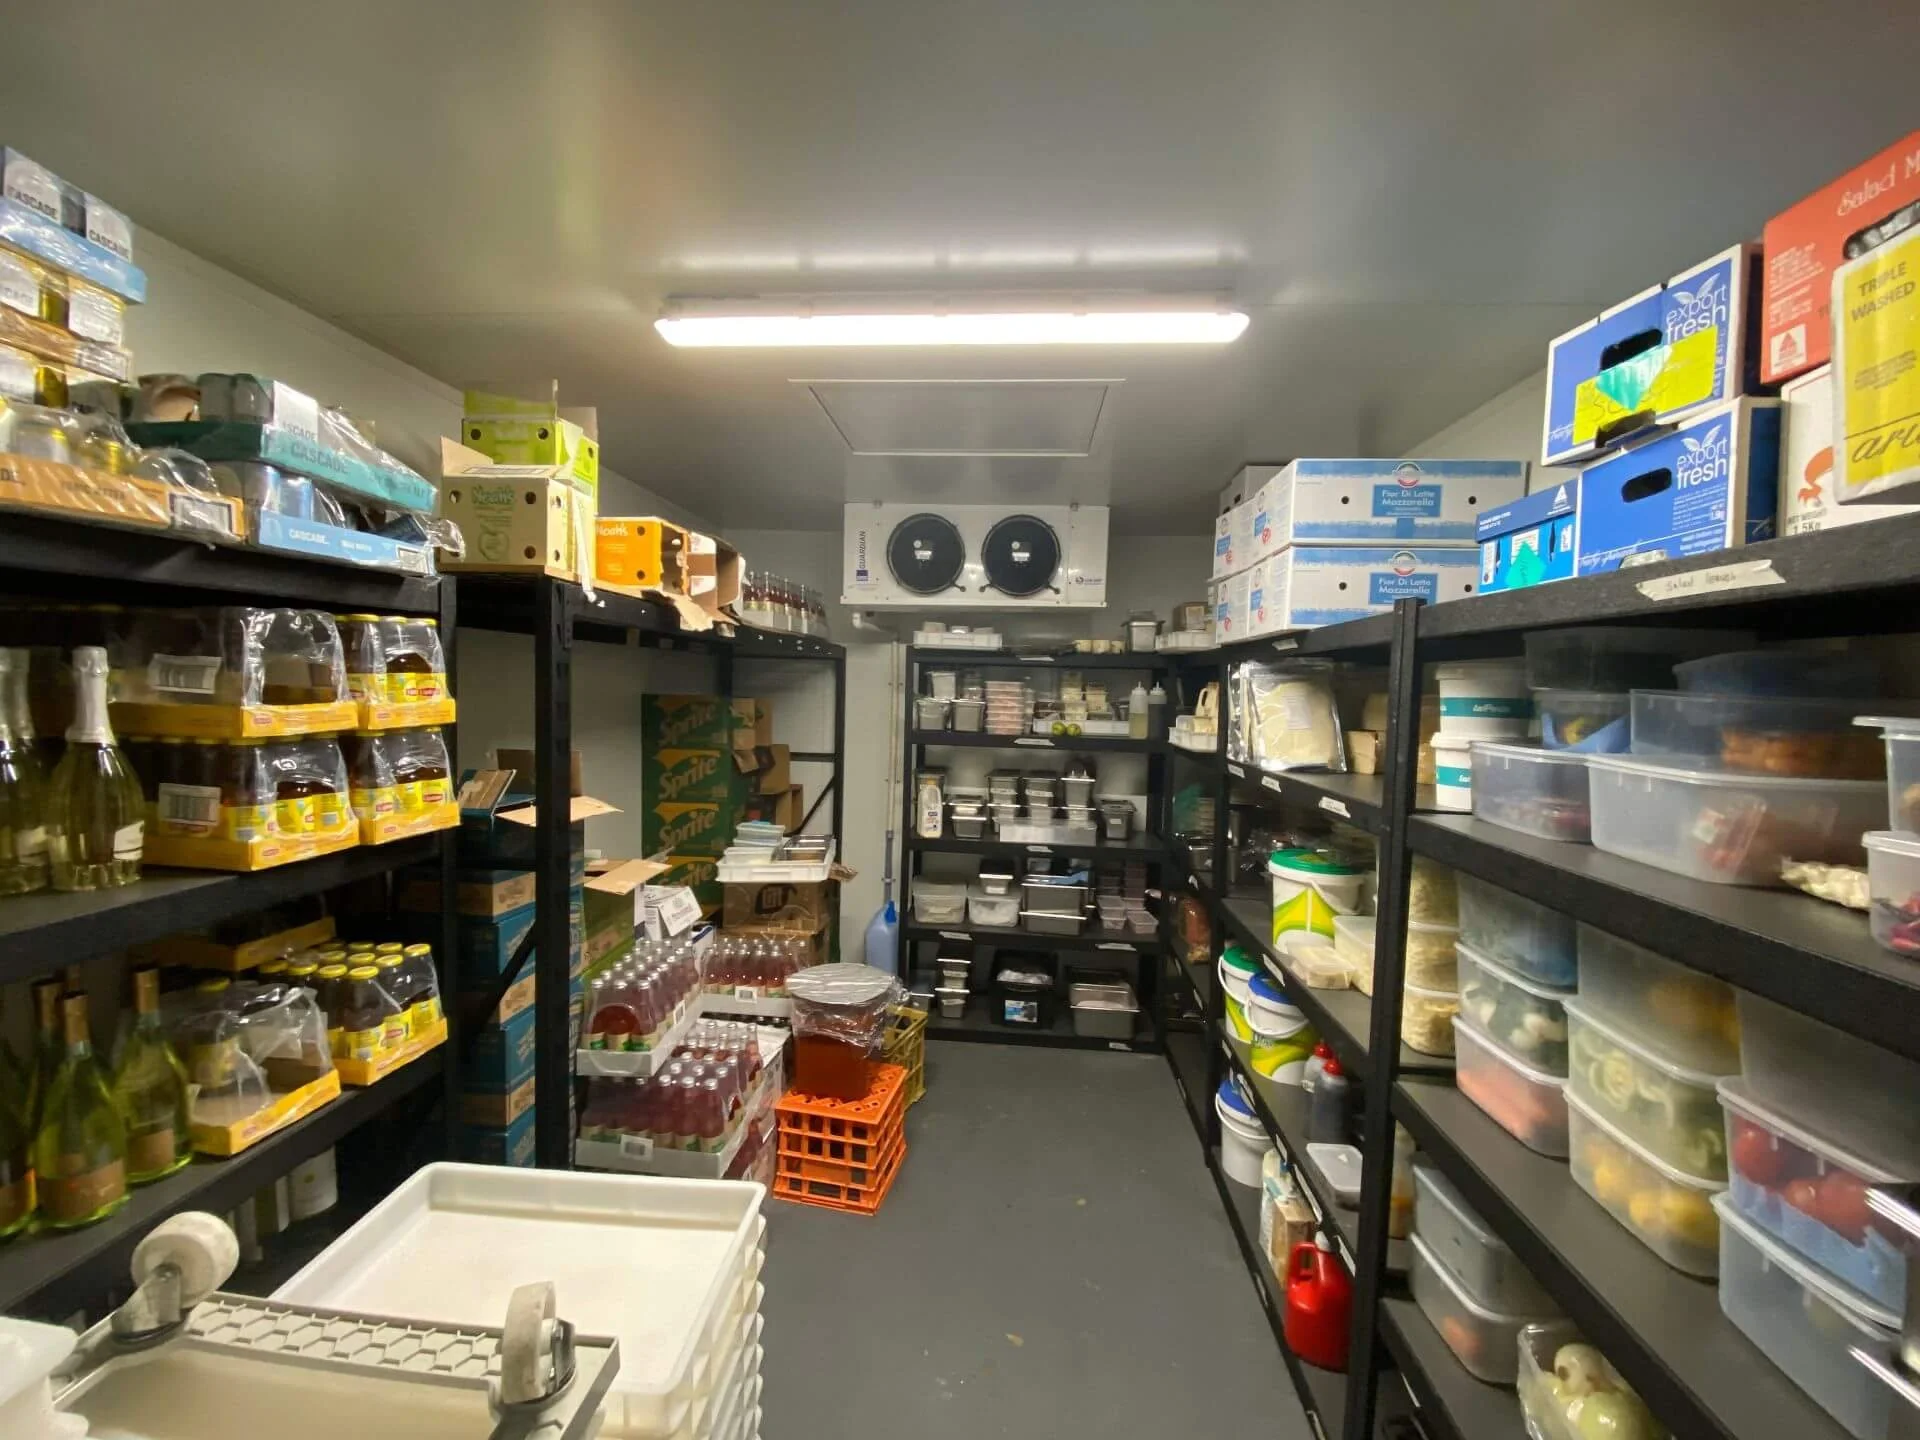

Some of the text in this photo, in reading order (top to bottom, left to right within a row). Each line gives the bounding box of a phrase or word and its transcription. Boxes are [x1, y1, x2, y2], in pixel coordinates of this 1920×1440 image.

[1837, 162, 1896, 216] Salad
[1858, 261, 1908, 297] TRIPLE
[1667, 283, 1727, 323] export
[1851, 281, 1917, 322] WASHED
[1666, 303, 1727, 345] fresh
[1676, 437, 1728, 468] export
[1676, 457, 1728, 491] fresh
[1382, 498, 1434, 506] Mozzarella
[1401, 490, 1412, 498] Di
[1414, 490, 1435, 498] Latte
[859, 530, 867, 569] GUARDIAN
[1378, 586, 1430, 594] Mozzarella
[1398, 578, 1408, 586] Di
[659, 701, 717, 748] Sprite
[658, 757, 718, 799] Sprite
[658, 810, 716, 852] Sprite
